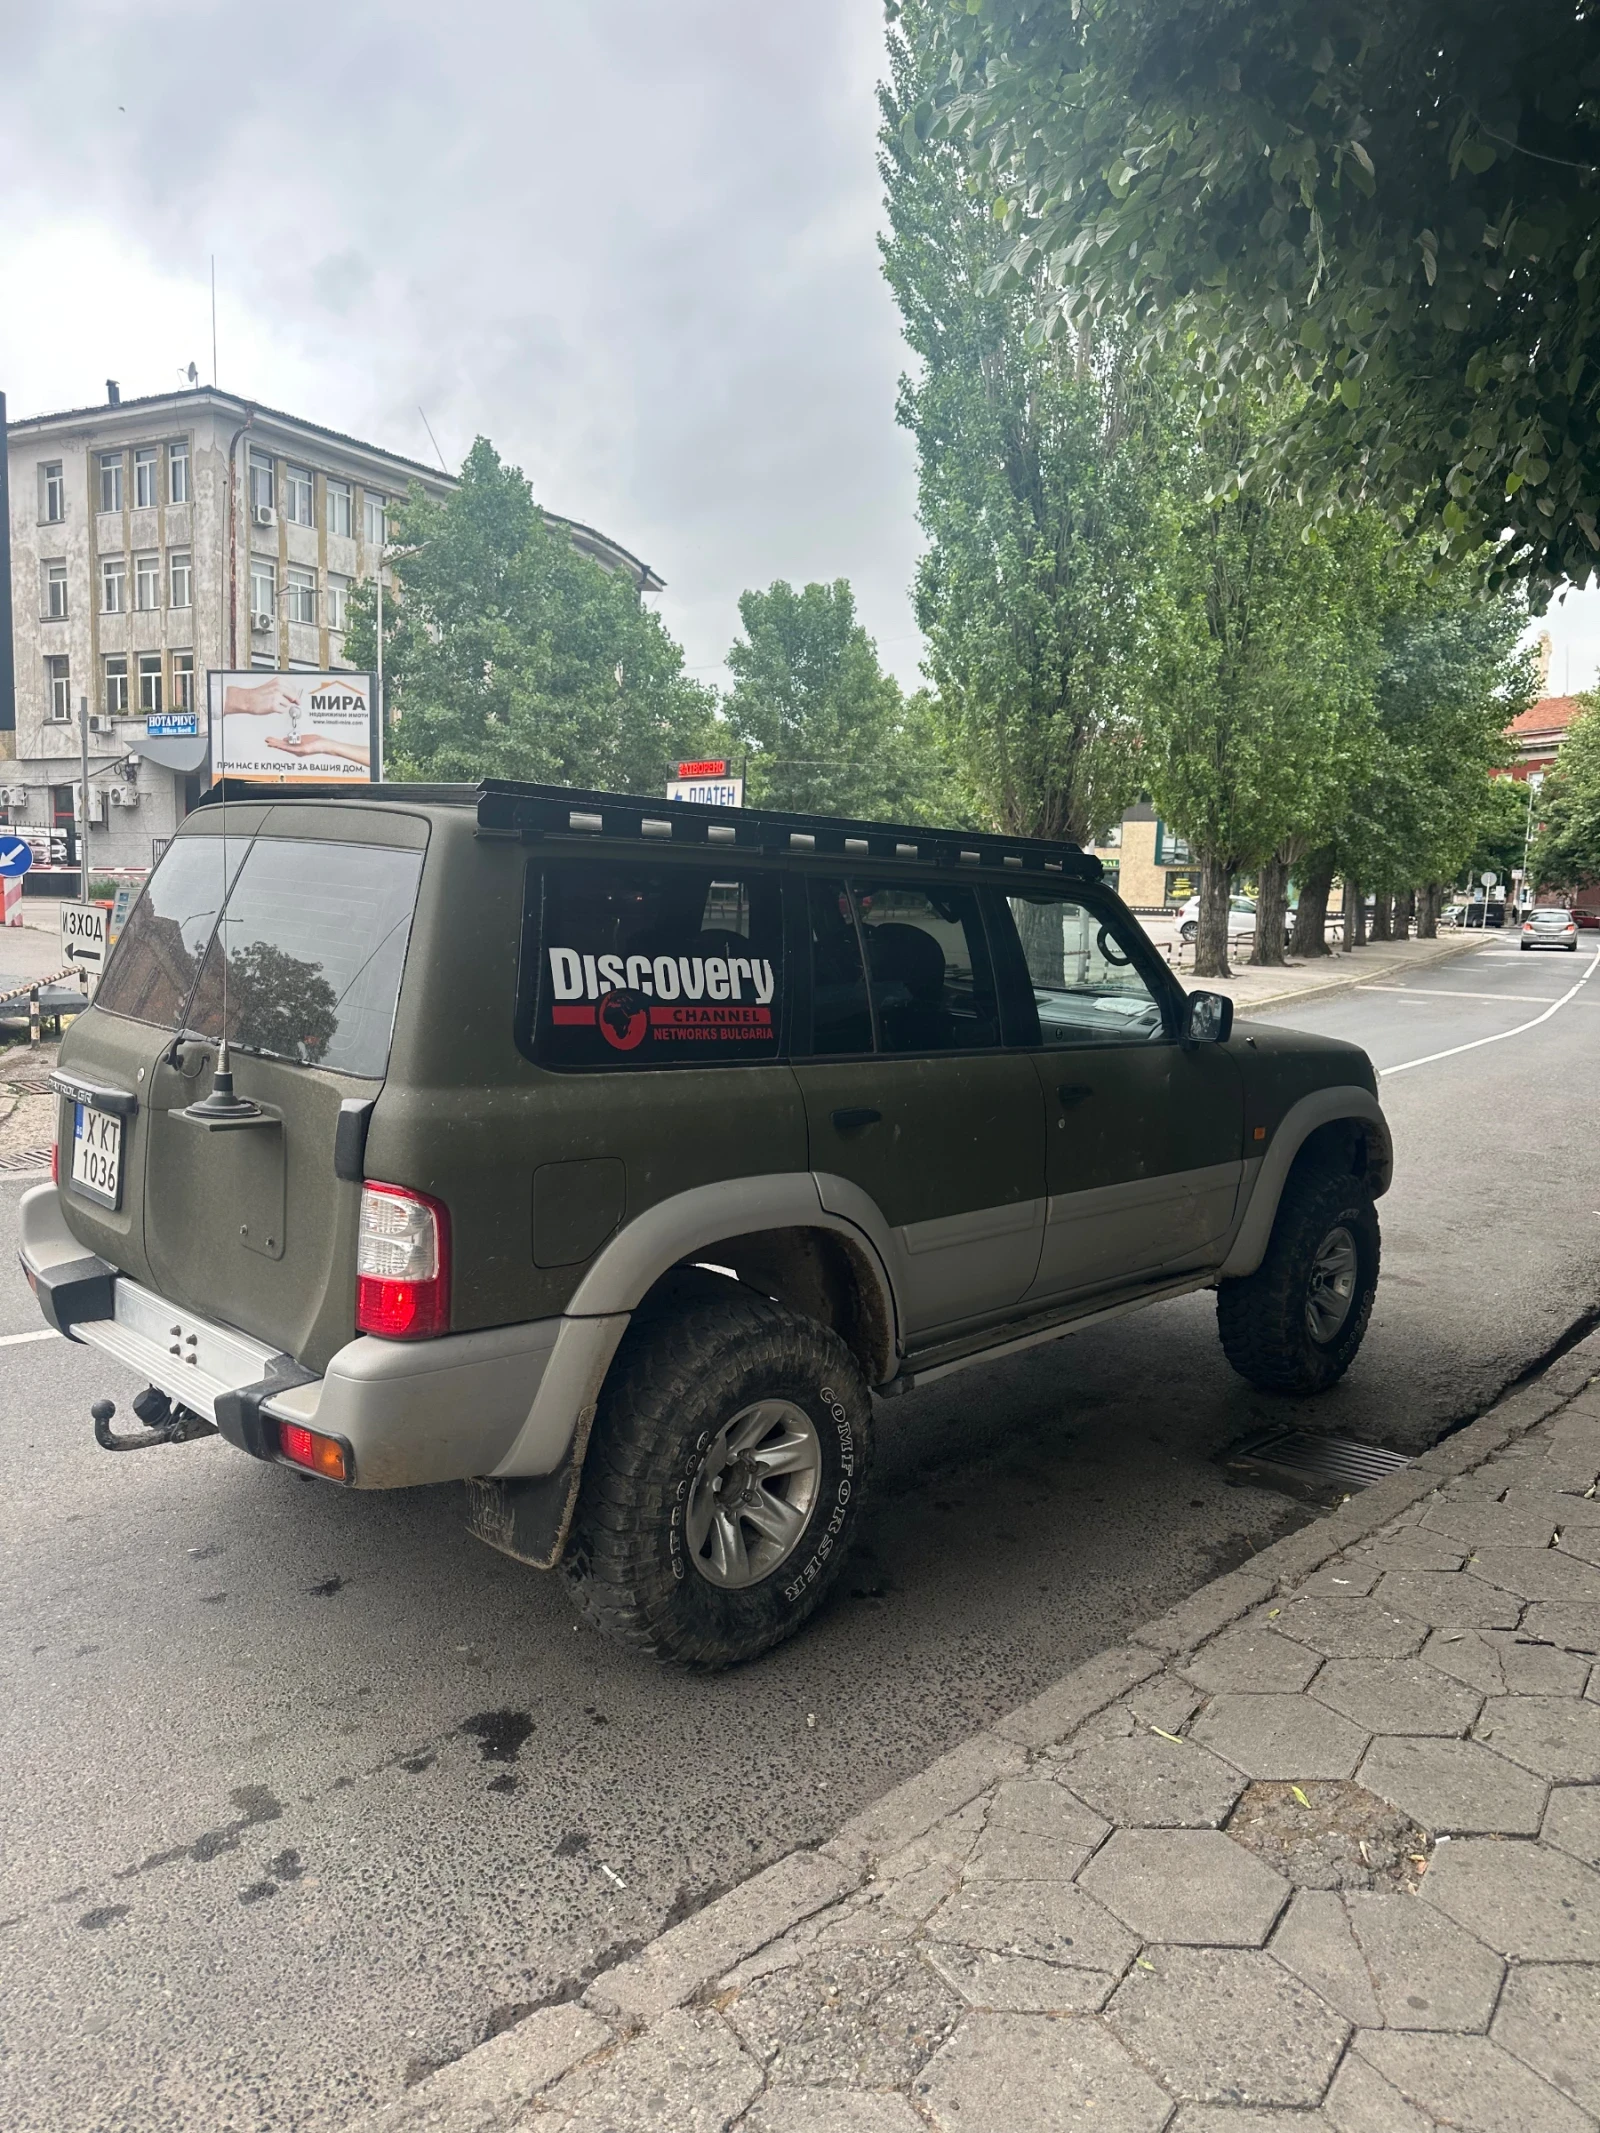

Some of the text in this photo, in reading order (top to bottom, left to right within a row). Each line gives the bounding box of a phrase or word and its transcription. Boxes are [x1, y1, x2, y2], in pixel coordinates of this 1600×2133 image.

[311, 695, 366, 711] МИРА
[148, 715, 195, 727] НОТАРИУС
[216, 761, 235, 770] ПРИ
[236, 762, 253, 770] НАС
[254, 762, 260, 770] Е
[260, 762, 296, 772] КЛЮЧЪТ
[297, 763, 308, 771] ЗА
[309, 763, 341, 772] ВАШИЯ
[678, 760, 725, 776] ЗАТВОРЕНО
[62, 911, 103, 942] ИЗХОД
[672, 1008, 761, 1023] CHANNEL
[653, 1027, 774, 1041] NETWORKS BULGARIA
[48, 1079, 93, 1104] PATROL GR
[83, 1149, 116, 1192] 1036
[784, 1386, 854, 1602] COMFORSER
